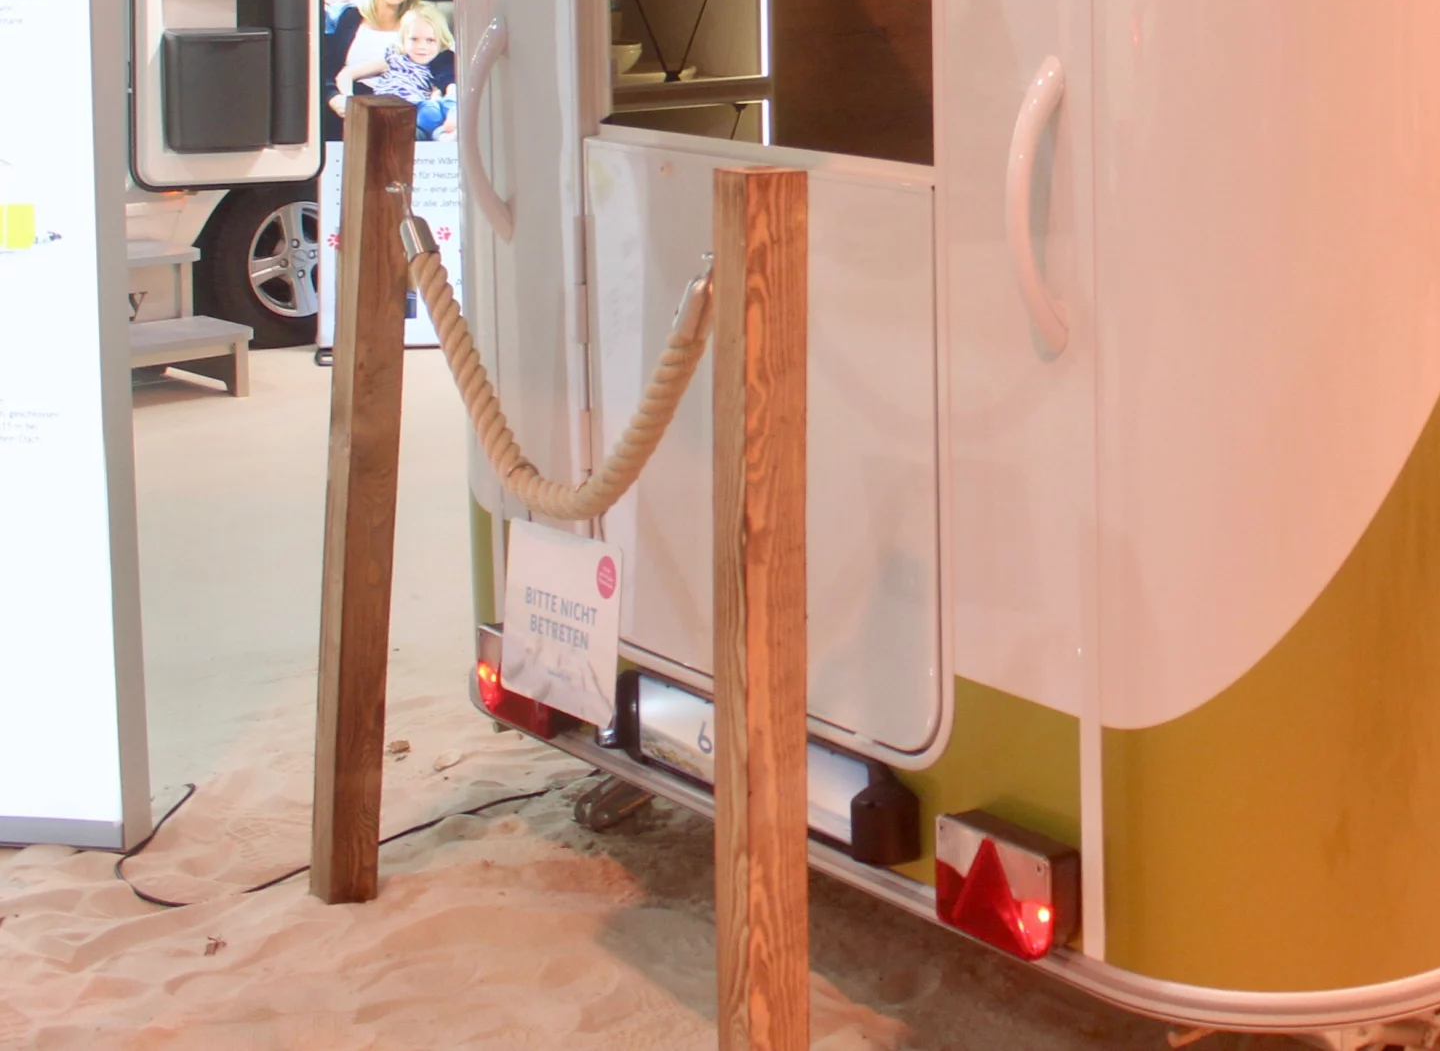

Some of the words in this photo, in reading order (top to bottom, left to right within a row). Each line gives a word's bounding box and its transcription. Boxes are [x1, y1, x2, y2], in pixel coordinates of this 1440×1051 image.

[525, 586, 557, 614] BITTE
[560, 598, 597, 627] NICHT
[530, 614, 589, 650] BETRETEN
